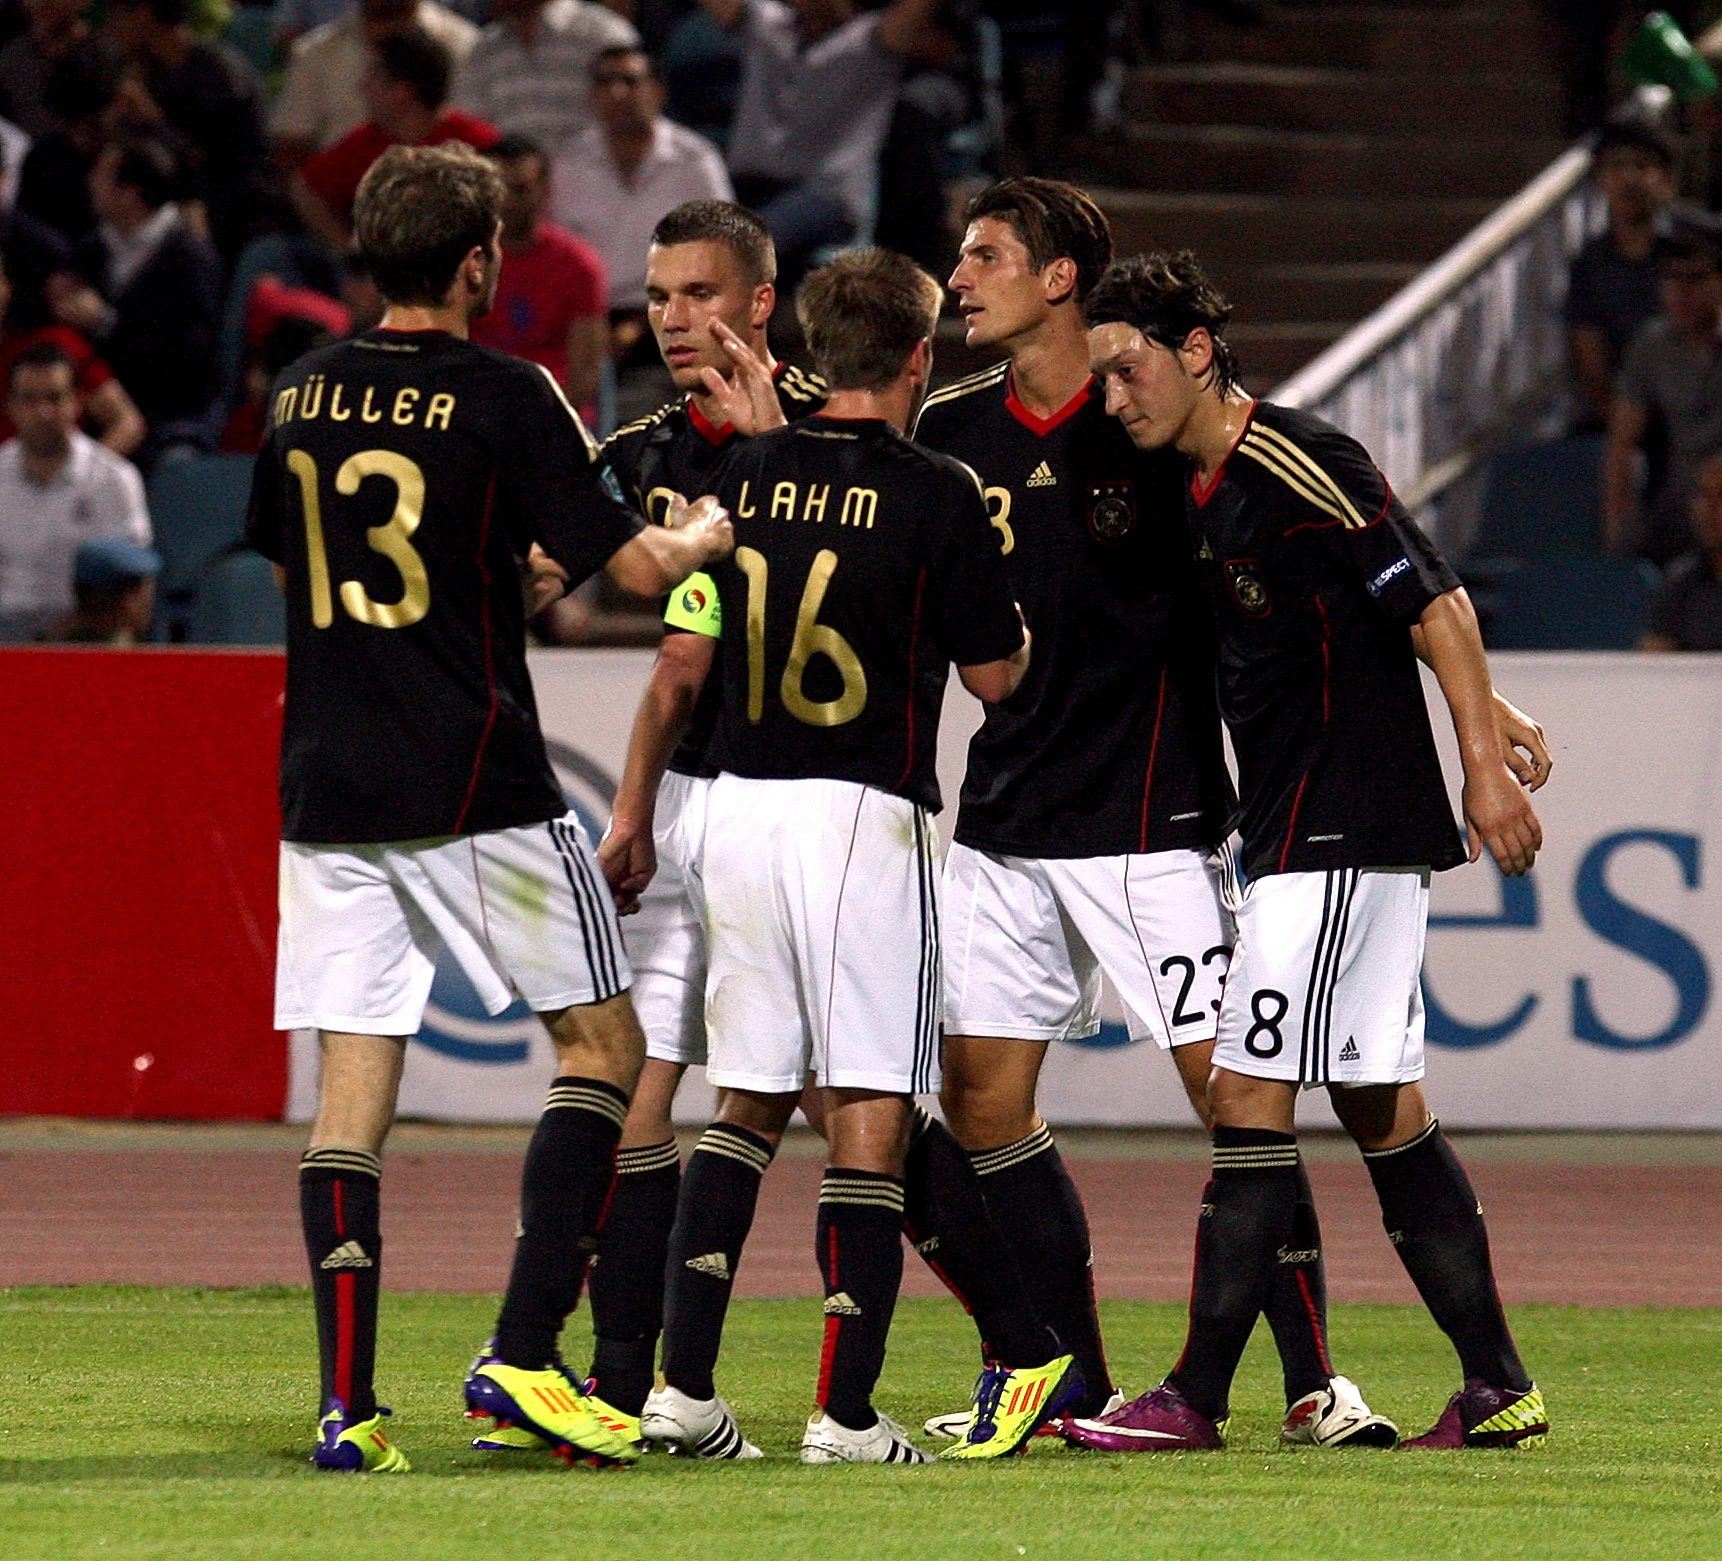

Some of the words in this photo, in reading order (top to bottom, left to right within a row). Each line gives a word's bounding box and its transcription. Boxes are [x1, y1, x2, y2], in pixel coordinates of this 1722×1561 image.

[274, 374, 456, 431] MÜLLER
[285, 448, 431, 630] 13
[737, 480, 878, 530] LAHM
[734, 545, 868, 727] 16
[1243, 988, 1289, 1060] 8
